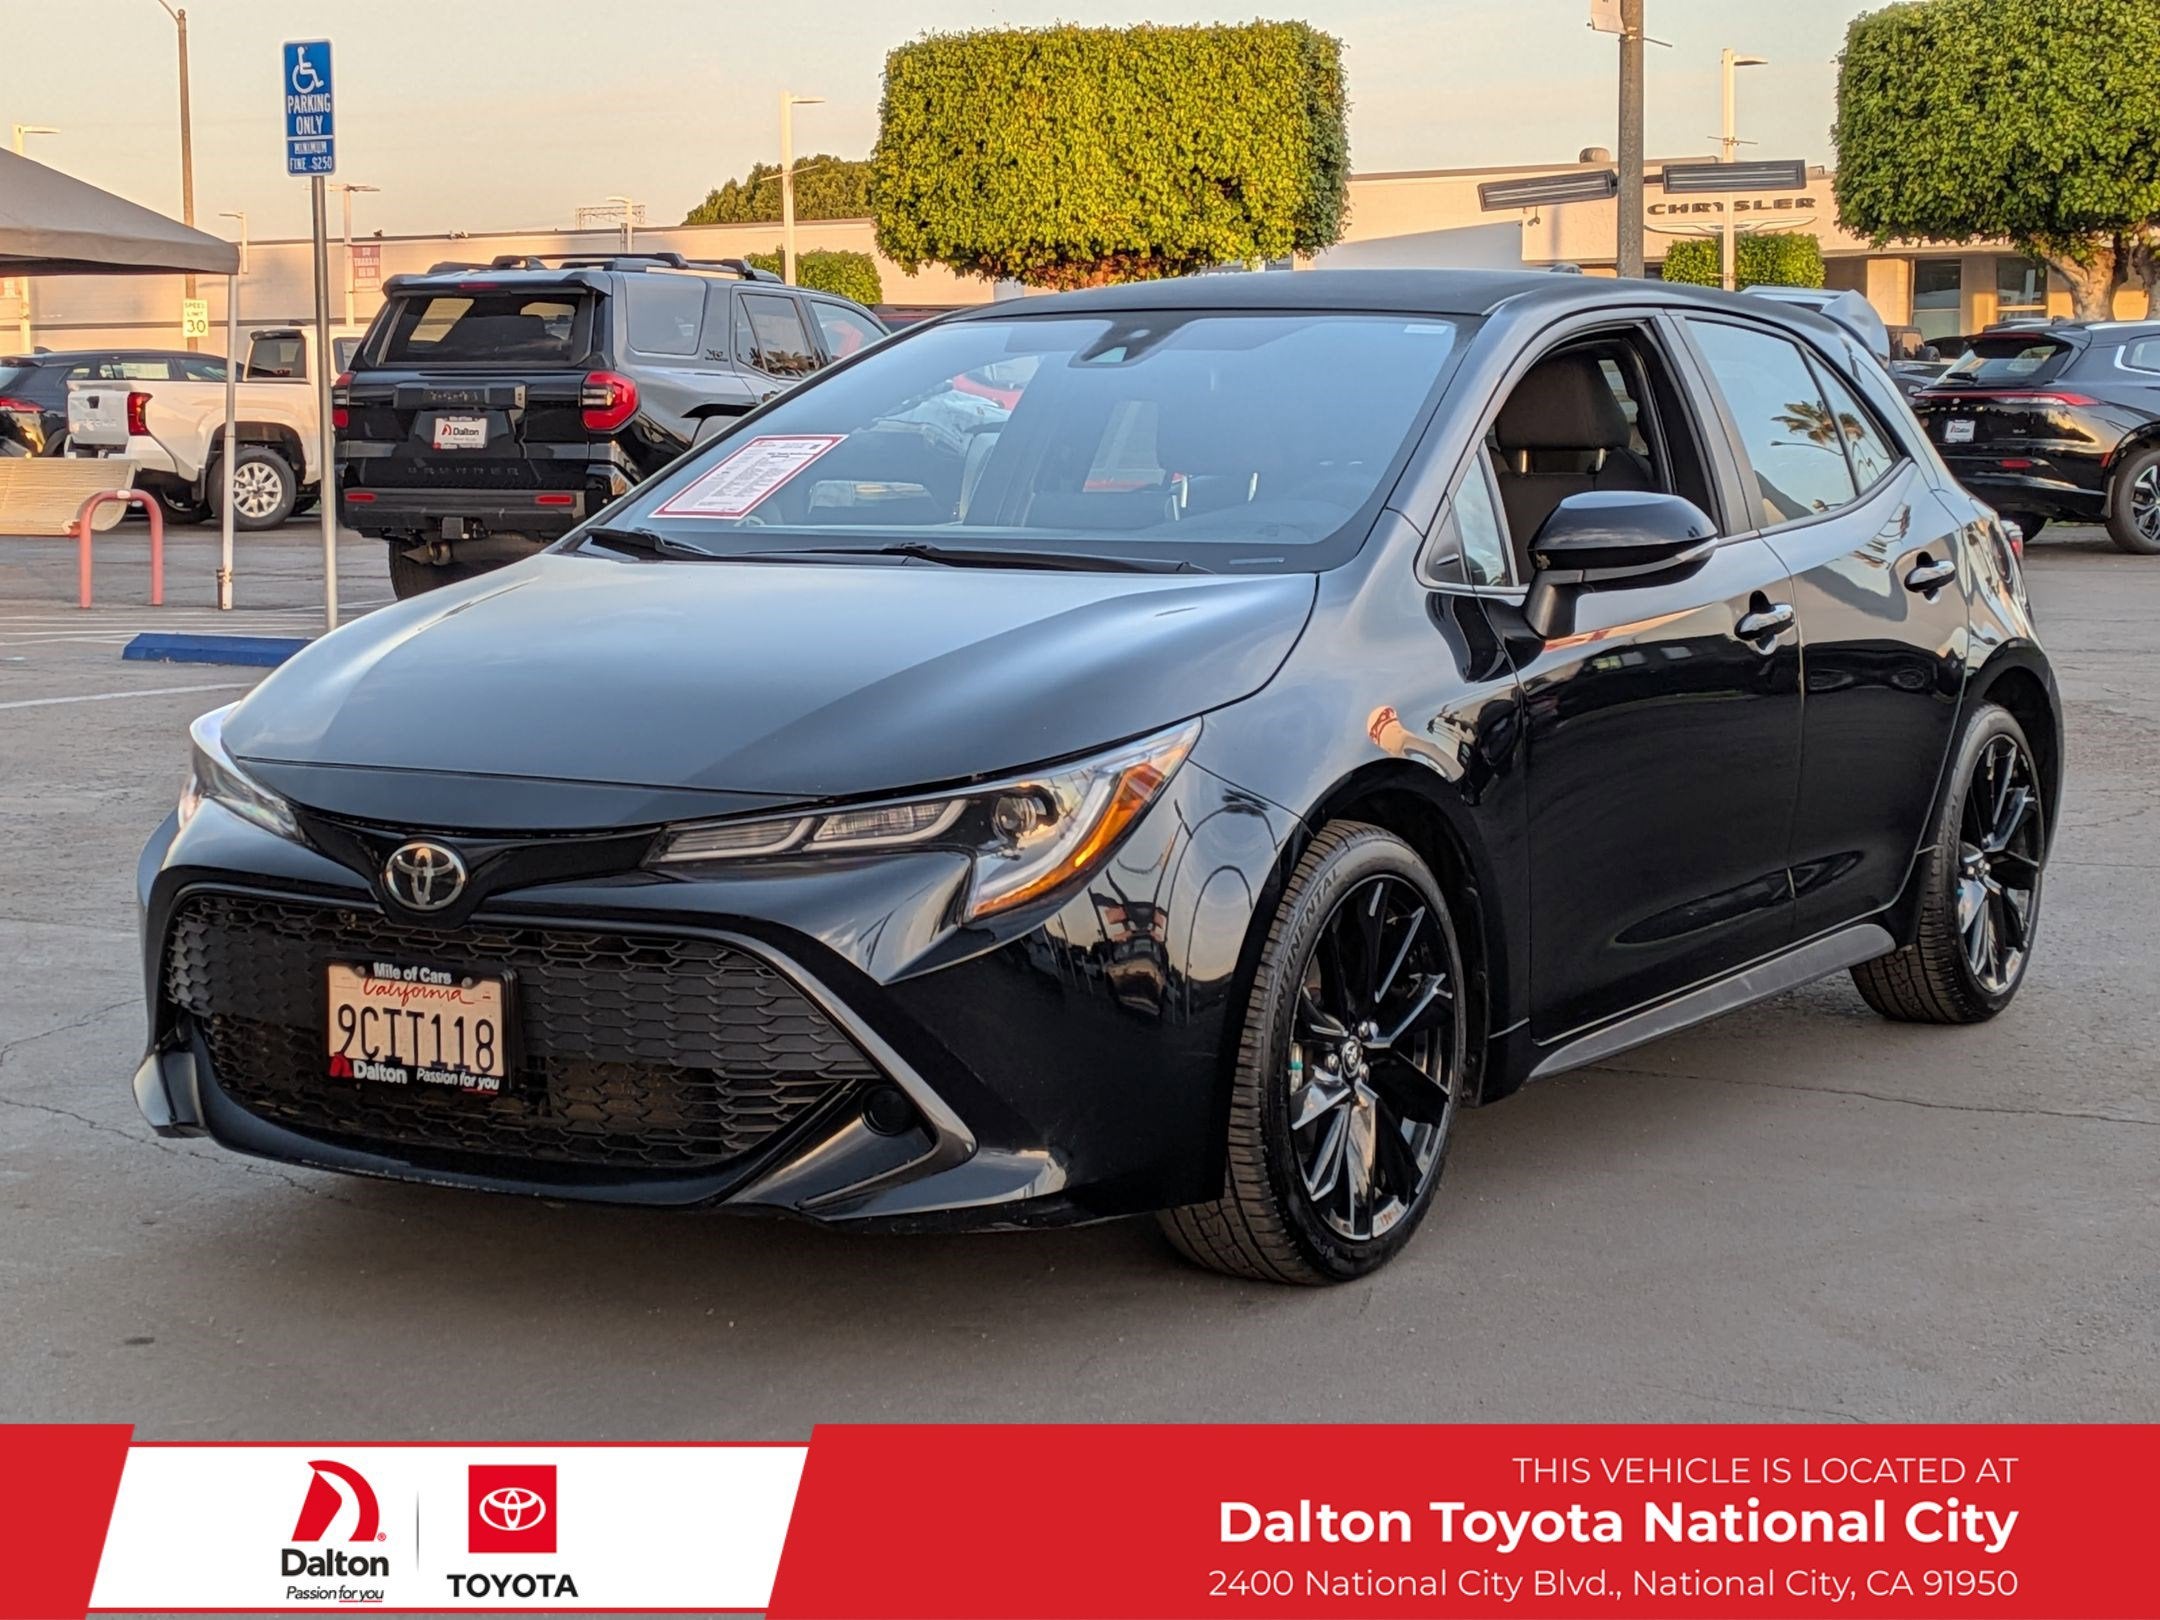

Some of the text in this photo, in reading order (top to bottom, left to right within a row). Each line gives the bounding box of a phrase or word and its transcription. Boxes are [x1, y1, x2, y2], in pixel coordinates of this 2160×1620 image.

[287, 93, 331, 114] PARKING
[295, 115, 323, 135] ONLY
[294, 141, 327, 155] MINIMUM
[311, 156, 333, 170] $250
[186, 319, 206, 333] 30
[453, 426, 480, 436] Dalton
[373, 961, 452, 984] Mile of Cars
[363, 976, 474, 1007] California
[337, 1003, 495, 1073] 9CIT118
[353, 1060, 500, 1091] Dalton Passion for you
